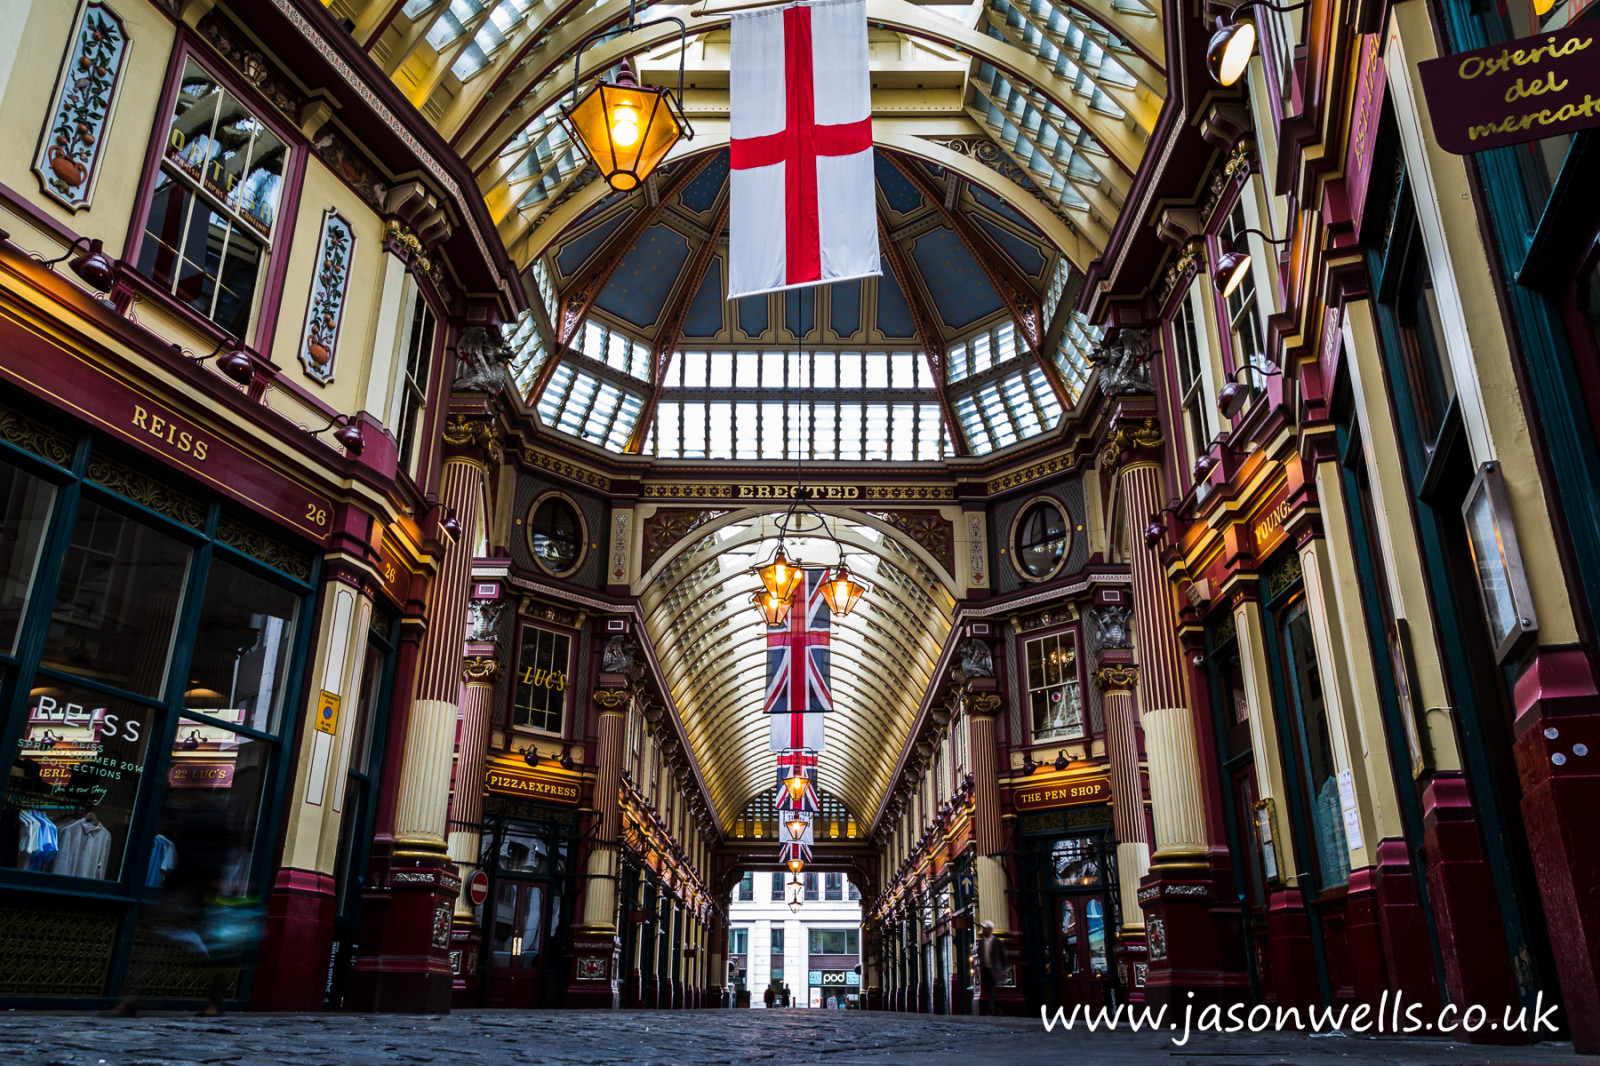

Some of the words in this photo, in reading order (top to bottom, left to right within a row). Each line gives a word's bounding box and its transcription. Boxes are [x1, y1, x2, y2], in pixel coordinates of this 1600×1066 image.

[1458, 36, 1593, 80] Osteria
[1504, 70, 1569, 103] del
[171, 127, 273, 227] ORTEGA
[131, 404, 209, 461] REISS
[305, 503, 327, 526] 26
[384, 562, 396, 584] 26
[522, 666, 568, 692] LUC'S
[36, 695, 141, 742] REISS
[17, 738, 117, 768] SPRING/SUMMER
[120, 761, 144, 773] 2014
[71, 738, 104, 753] REISS
[41, 756, 121, 780] COLLECTIONS
[174, 769, 188, 779] 22
[191, 768, 227, 779] LUC'S
[490, 775, 577, 797] PIZZAEXPRESS
[1021, 792, 1041, 803] THE
[1045, 789, 1067, 800] PEN
[1071, 784, 1101, 797] SHOP
[823, 971, 845, 985] pod
